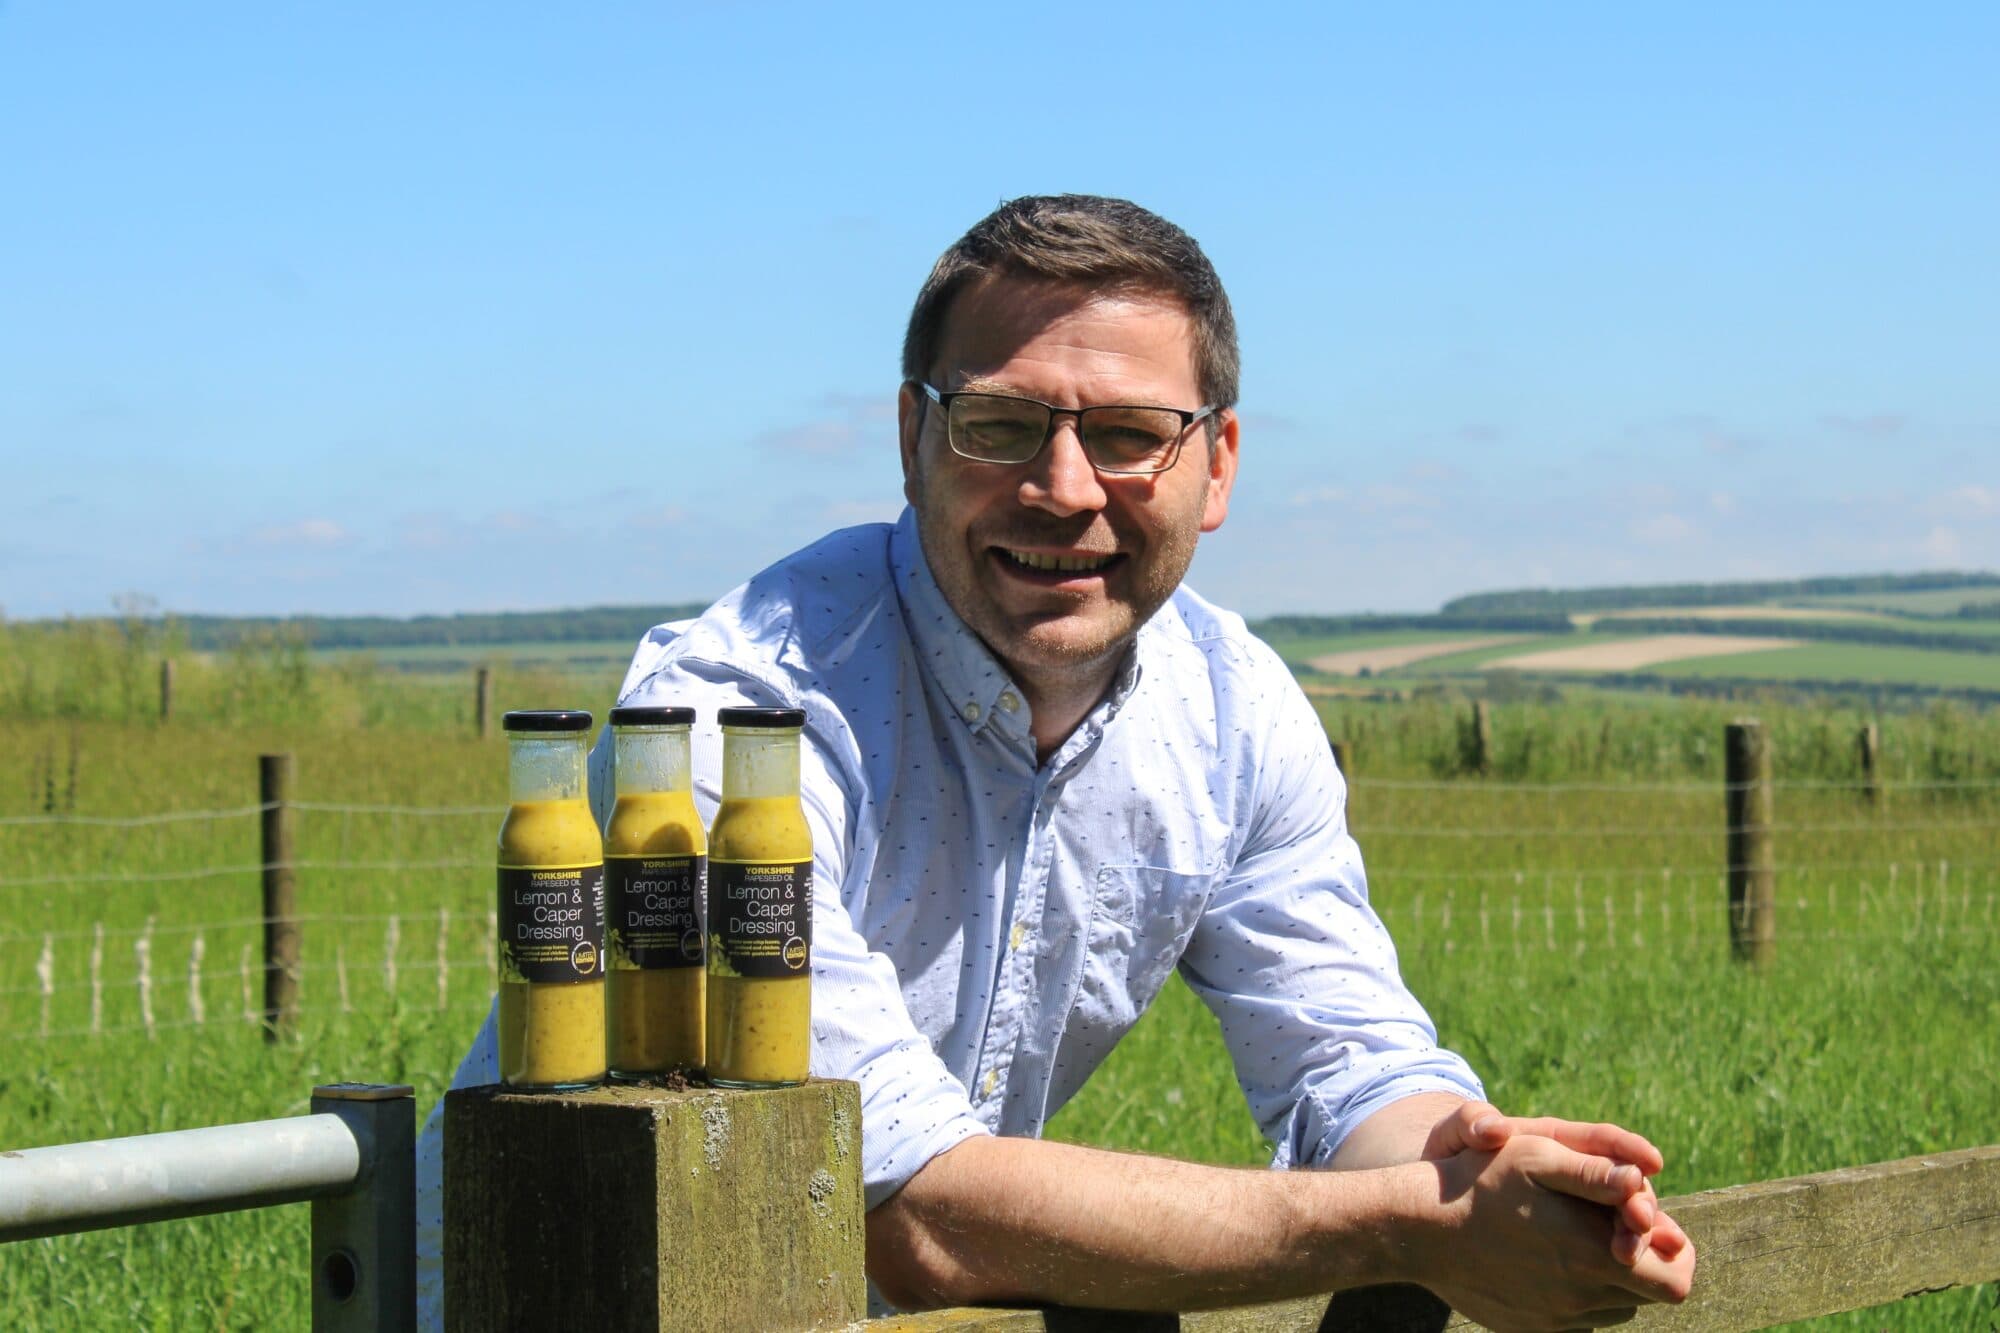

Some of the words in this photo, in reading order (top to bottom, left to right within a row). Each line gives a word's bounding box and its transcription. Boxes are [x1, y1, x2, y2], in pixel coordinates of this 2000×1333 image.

[642, 860, 690, 868] YORKSHIRE
[745, 866, 795, 875] YORKSHIRE
[532, 871, 582, 880] YORKSHIRE
[625, 877, 677, 893] Lemon
[681, 876, 691, 892] &
[728, 883, 780, 899] Lemon
[784, 883, 795, 899] &
[514, 888, 567, 905] Lemon
[571, 888, 583, 904] &
[644, 894, 691, 912] Caper
[534, 906, 583, 924] Caper
[747, 901, 795, 919] Caper
[628, 910, 692, 928] Dressing
[730, 917, 795, 936] Dressing
[517, 923, 584, 942] Dressing
